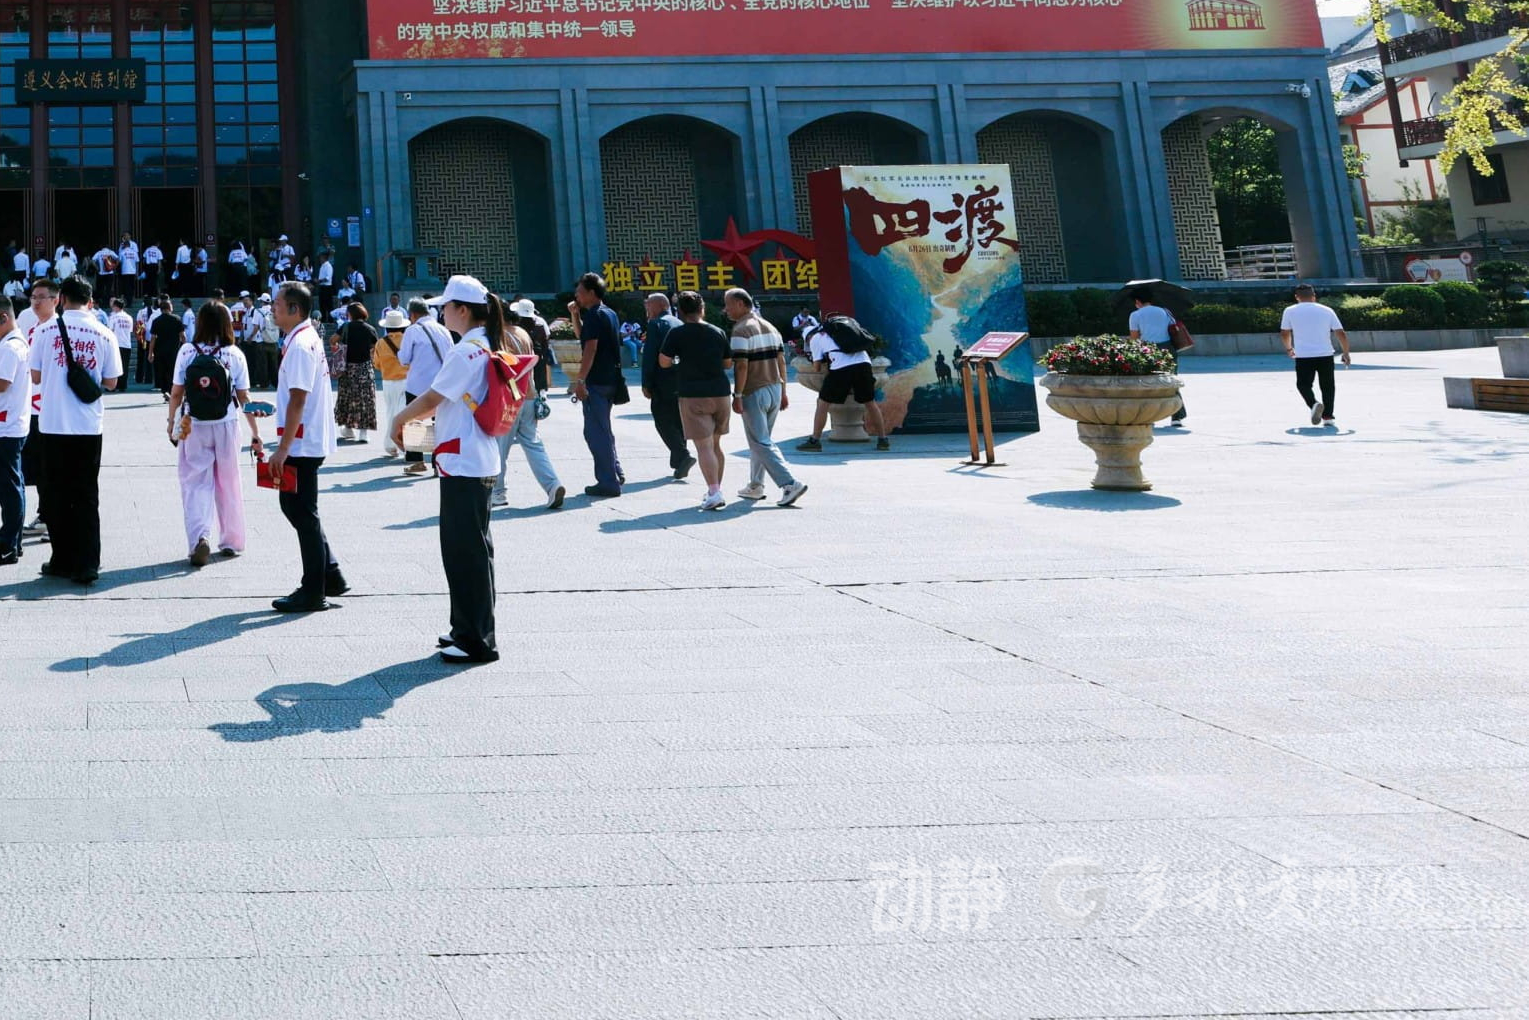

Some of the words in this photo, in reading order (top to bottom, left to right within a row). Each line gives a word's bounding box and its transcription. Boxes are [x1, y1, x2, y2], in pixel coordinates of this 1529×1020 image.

[397, 20, 636, 41] 的党中央权威和集中统一领导
[22, 68, 139, 92] 遵义会议陈列馆
[602, 260, 737, 292] 独立自主
